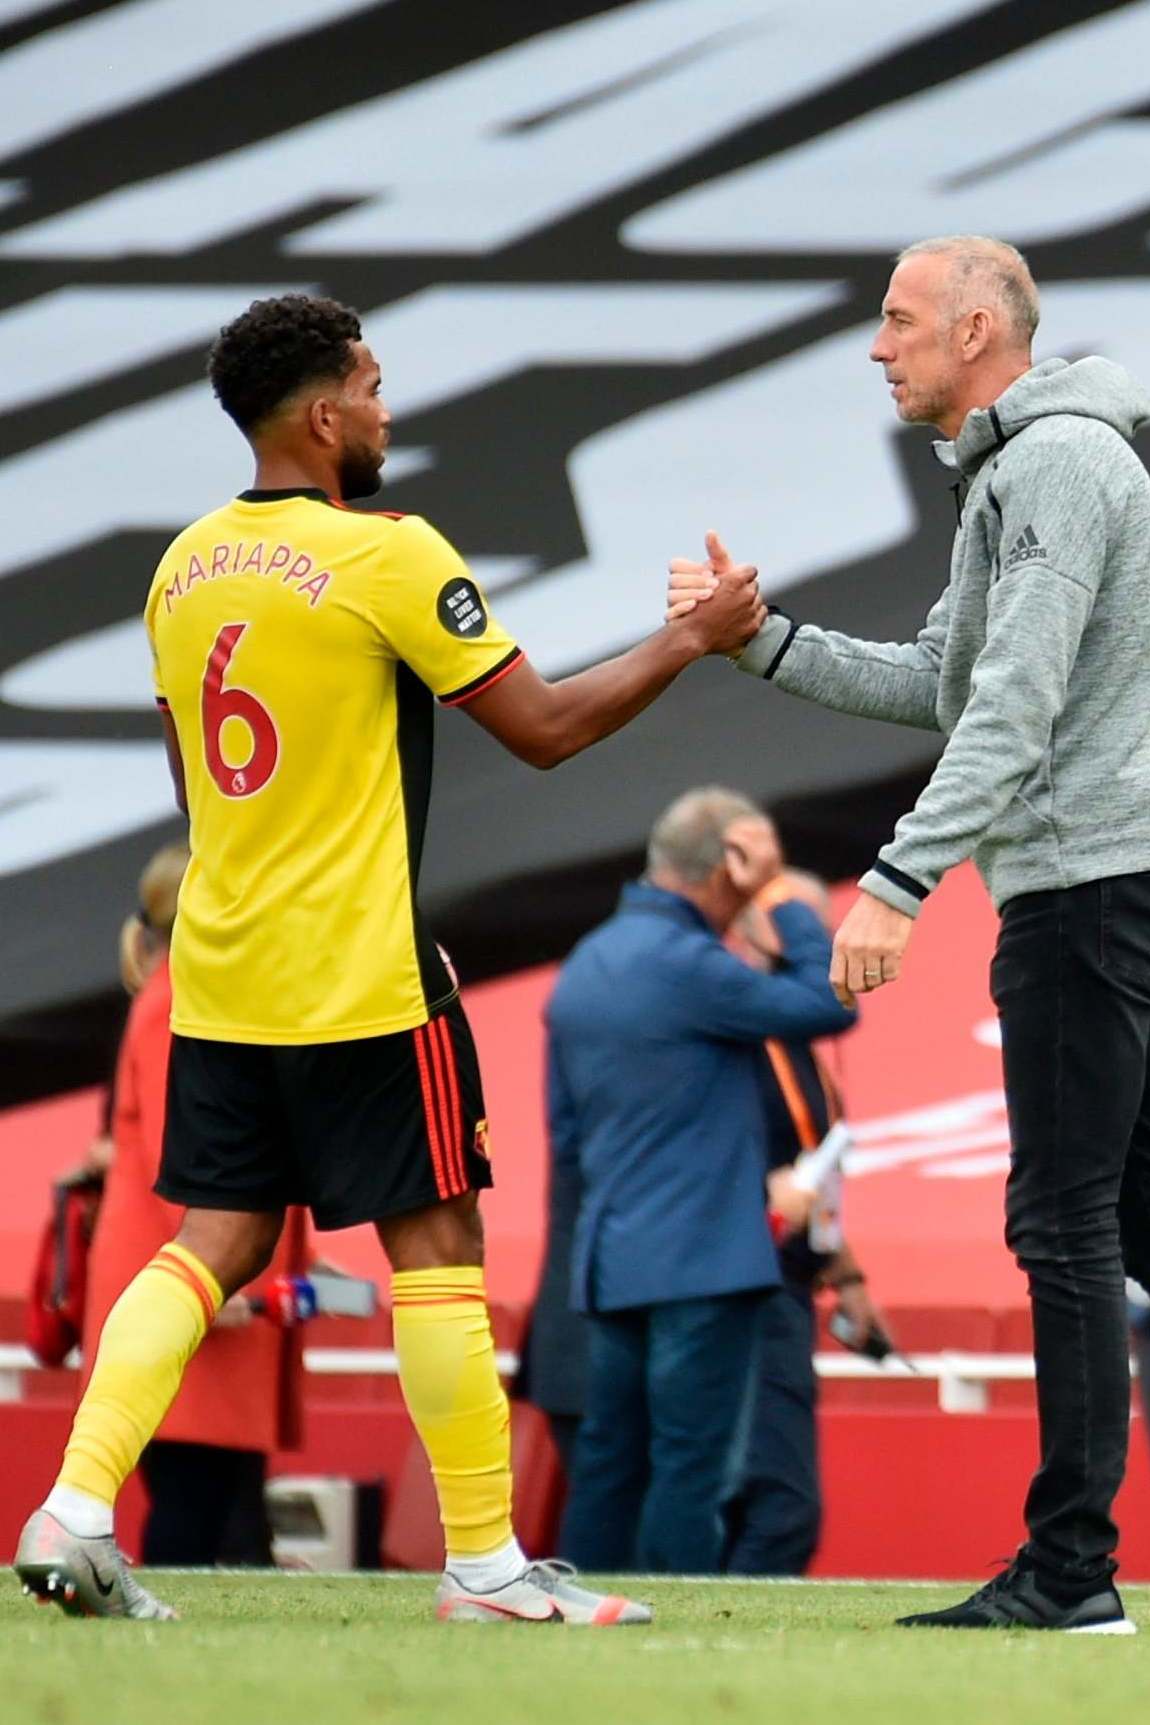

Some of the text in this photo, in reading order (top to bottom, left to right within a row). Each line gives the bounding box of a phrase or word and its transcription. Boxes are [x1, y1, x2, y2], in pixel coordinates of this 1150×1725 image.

[164, 541, 331, 615] MARIAPPA
[1003, 548, 1047, 570] adidas
[202, 622, 280, 800] 6
